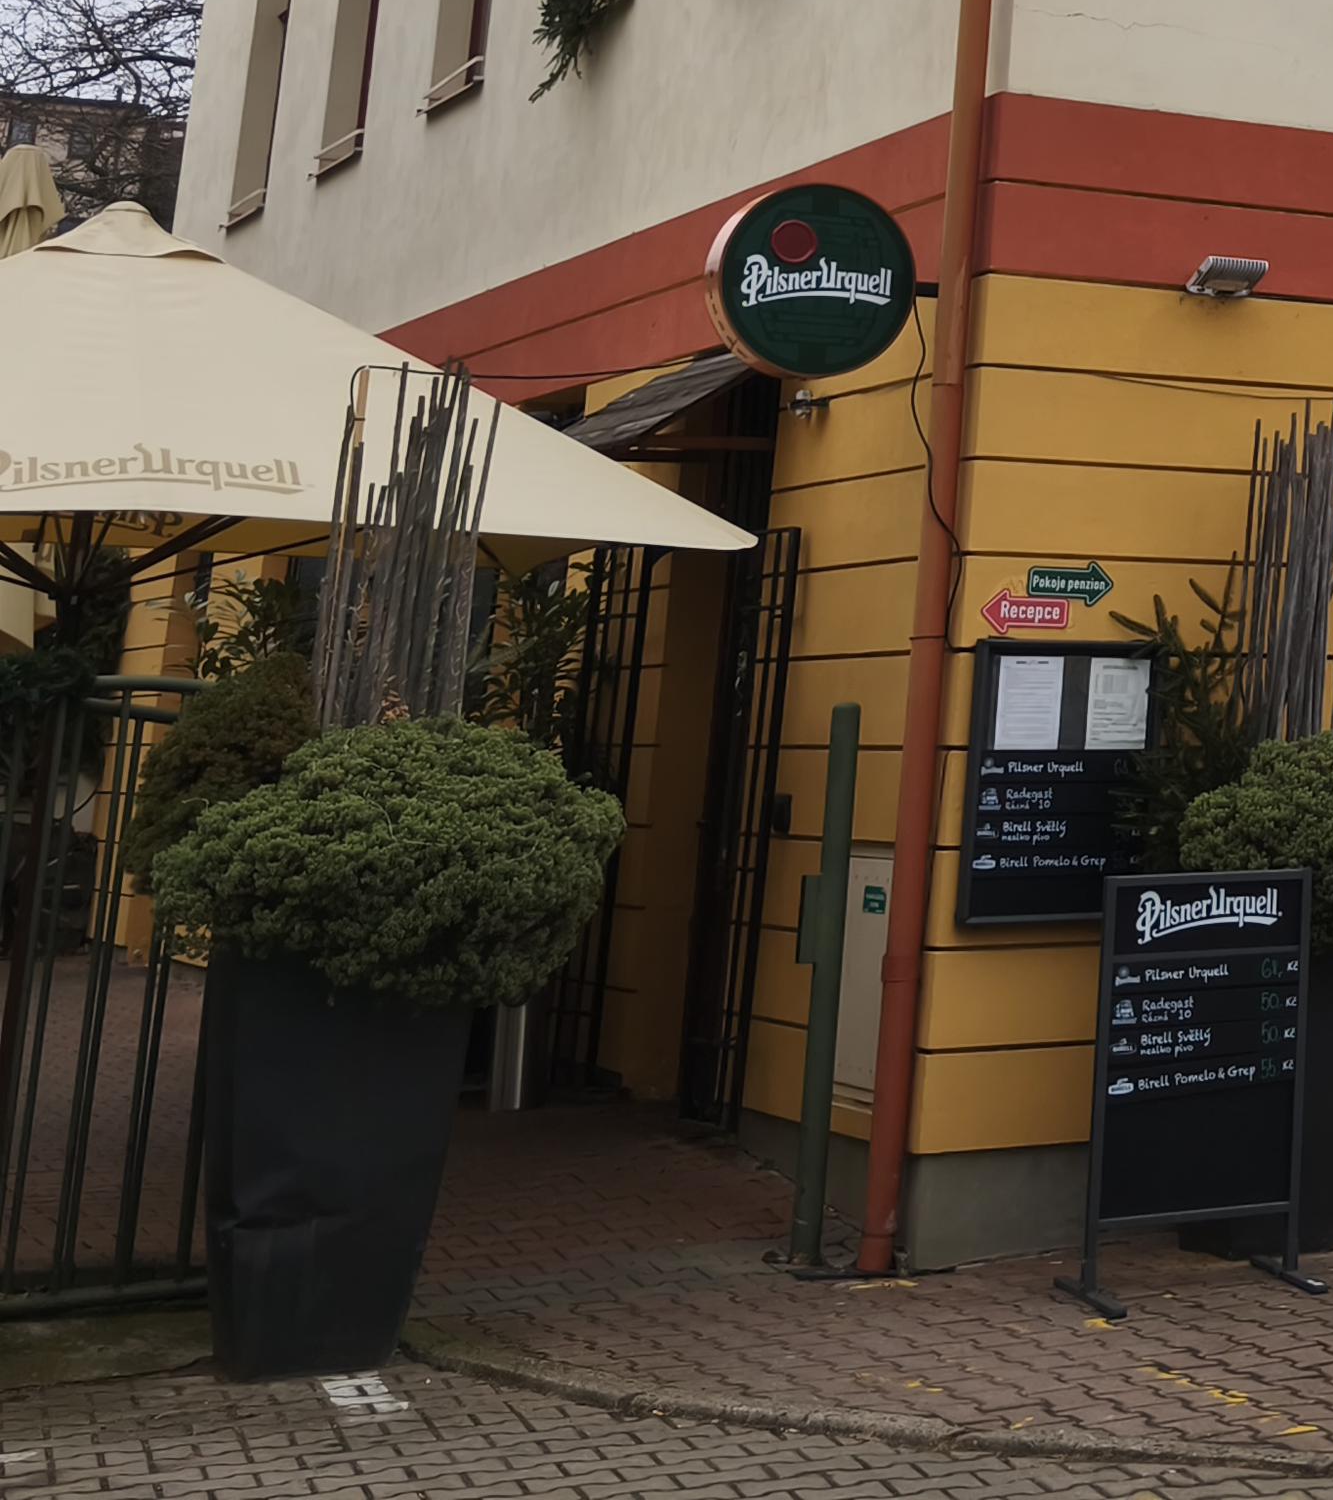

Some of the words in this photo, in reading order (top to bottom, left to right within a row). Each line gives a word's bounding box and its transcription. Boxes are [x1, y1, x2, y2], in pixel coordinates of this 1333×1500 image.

[0, 450, 138, 486] ilsner
[1033, 575, 1065, 592] Pokoje
[1067, 577, 1106, 592] penzion
[1000, 601, 1060, 623] Recepce
[1008, 761, 1043, 773] Pilsner
[1047, 761, 1084, 777] Urquell
[1006, 787, 1053, 802] Radegast
[1038, 800, 1051, 809] 10
[1003, 821, 1031, 832] Birell
[1036, 819, 1067, 838] Světlý
[1032, 833, 1050, 845] pivo
[1000, 856, 1028, 868] Birell
[1033, 856, 1070, 867] Pomelo
[1080, 855, 1106, 871] Grep
[1145, 969, 1185, 982] Pilsner
[1188, 964, 1229, 984] Urquell
[1287, 960, 1299, 971] Kč
[1142, 996, 1194, 1013] Radegast
[1285, 996, 1297, 1007] Kč
[1179, 1010, 1192, 1020] 10
[1140, 1032, 1172, 1046] Birell
[1178, 1028, 1211, 1046] Světlý
[1284, 1027, 1296, 1039] Kč
[1140, 1045, 1171, 1055] nealko
[1174, 1045, 1193, 1058] pivo
[1138, 1075, 1169, 1091] Birell
[1175, 1071, 1216, 1085] Pomelo
[1218, 1068, 1225, 1079] &
[1227, 1065, 1256, 1082] Grep
[1282, 1060, 1294, 1070] Kč
